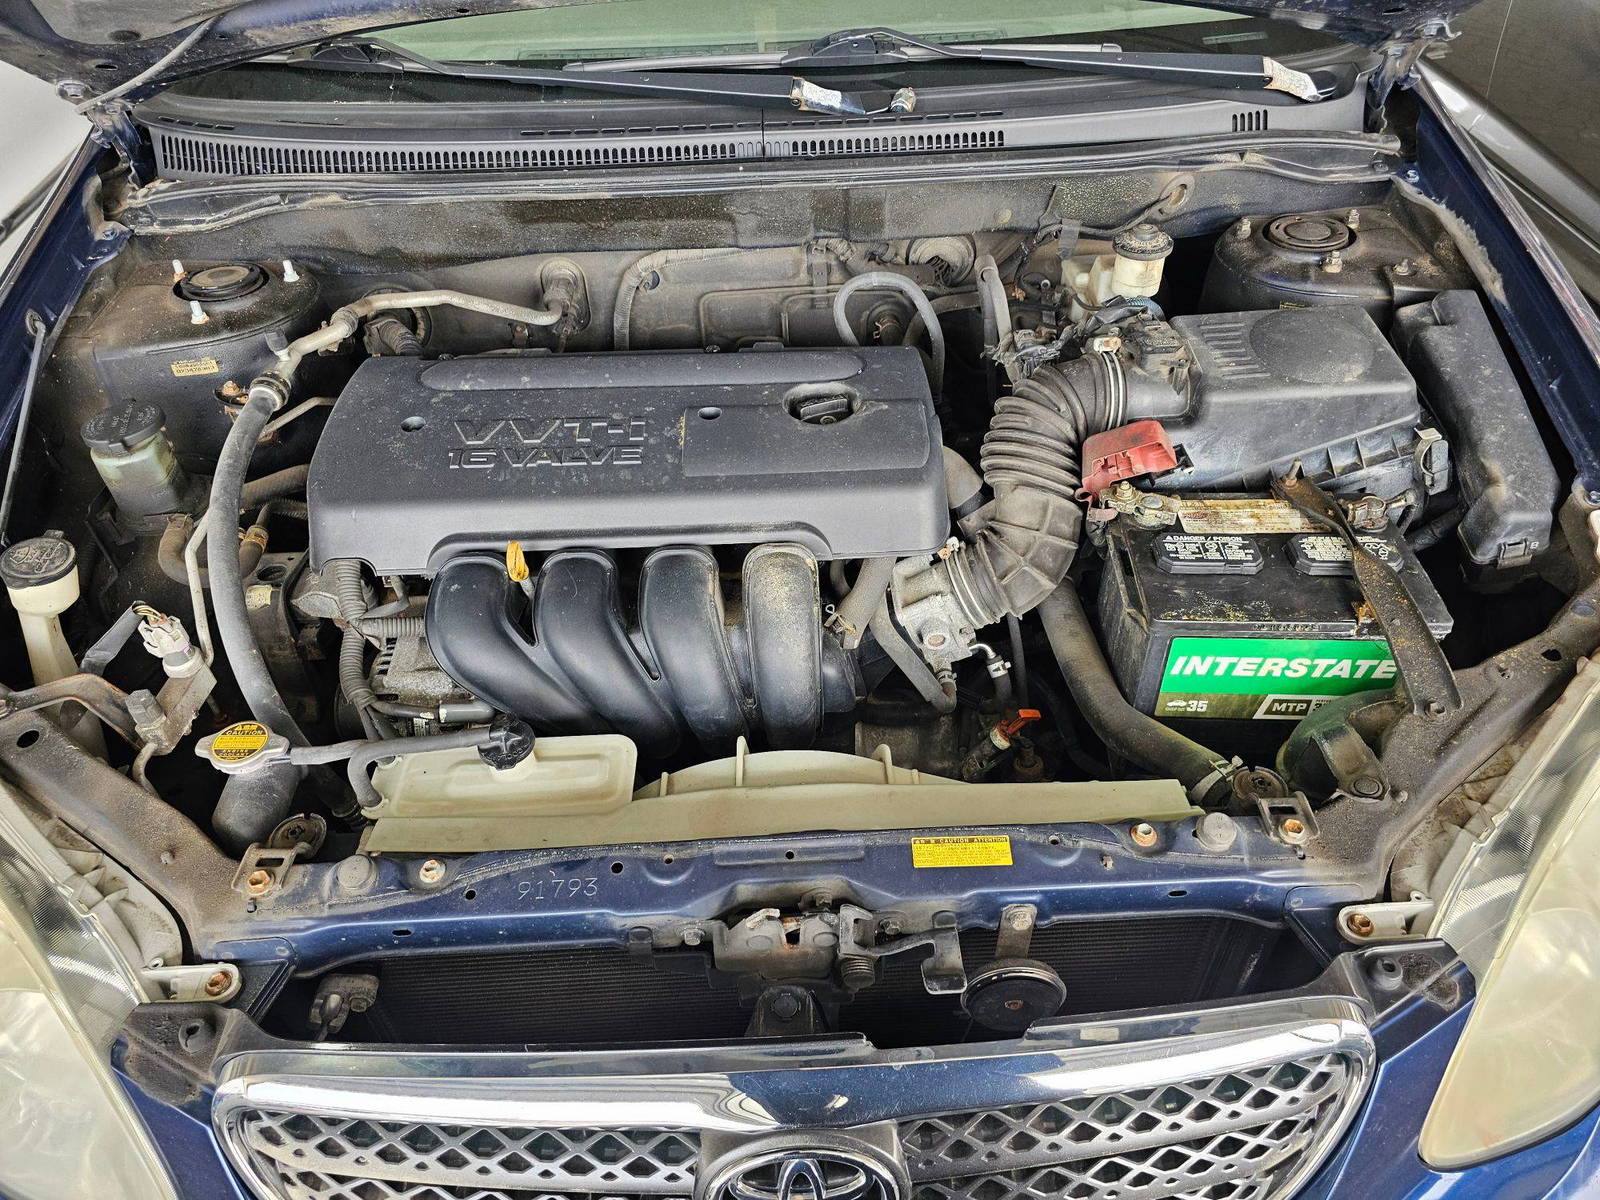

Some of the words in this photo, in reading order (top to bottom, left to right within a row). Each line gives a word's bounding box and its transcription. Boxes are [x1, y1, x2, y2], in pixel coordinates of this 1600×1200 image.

[448, 449, 497, 469] 16
[501, 445, 644, 468] VALVE
[1170, 655, 1398, 679] INTERSTATE
[1186, 700, 1209, 712] 35
[1271, 702, 1308, 712] MTP
[518, 877, 599, 900] 91793
